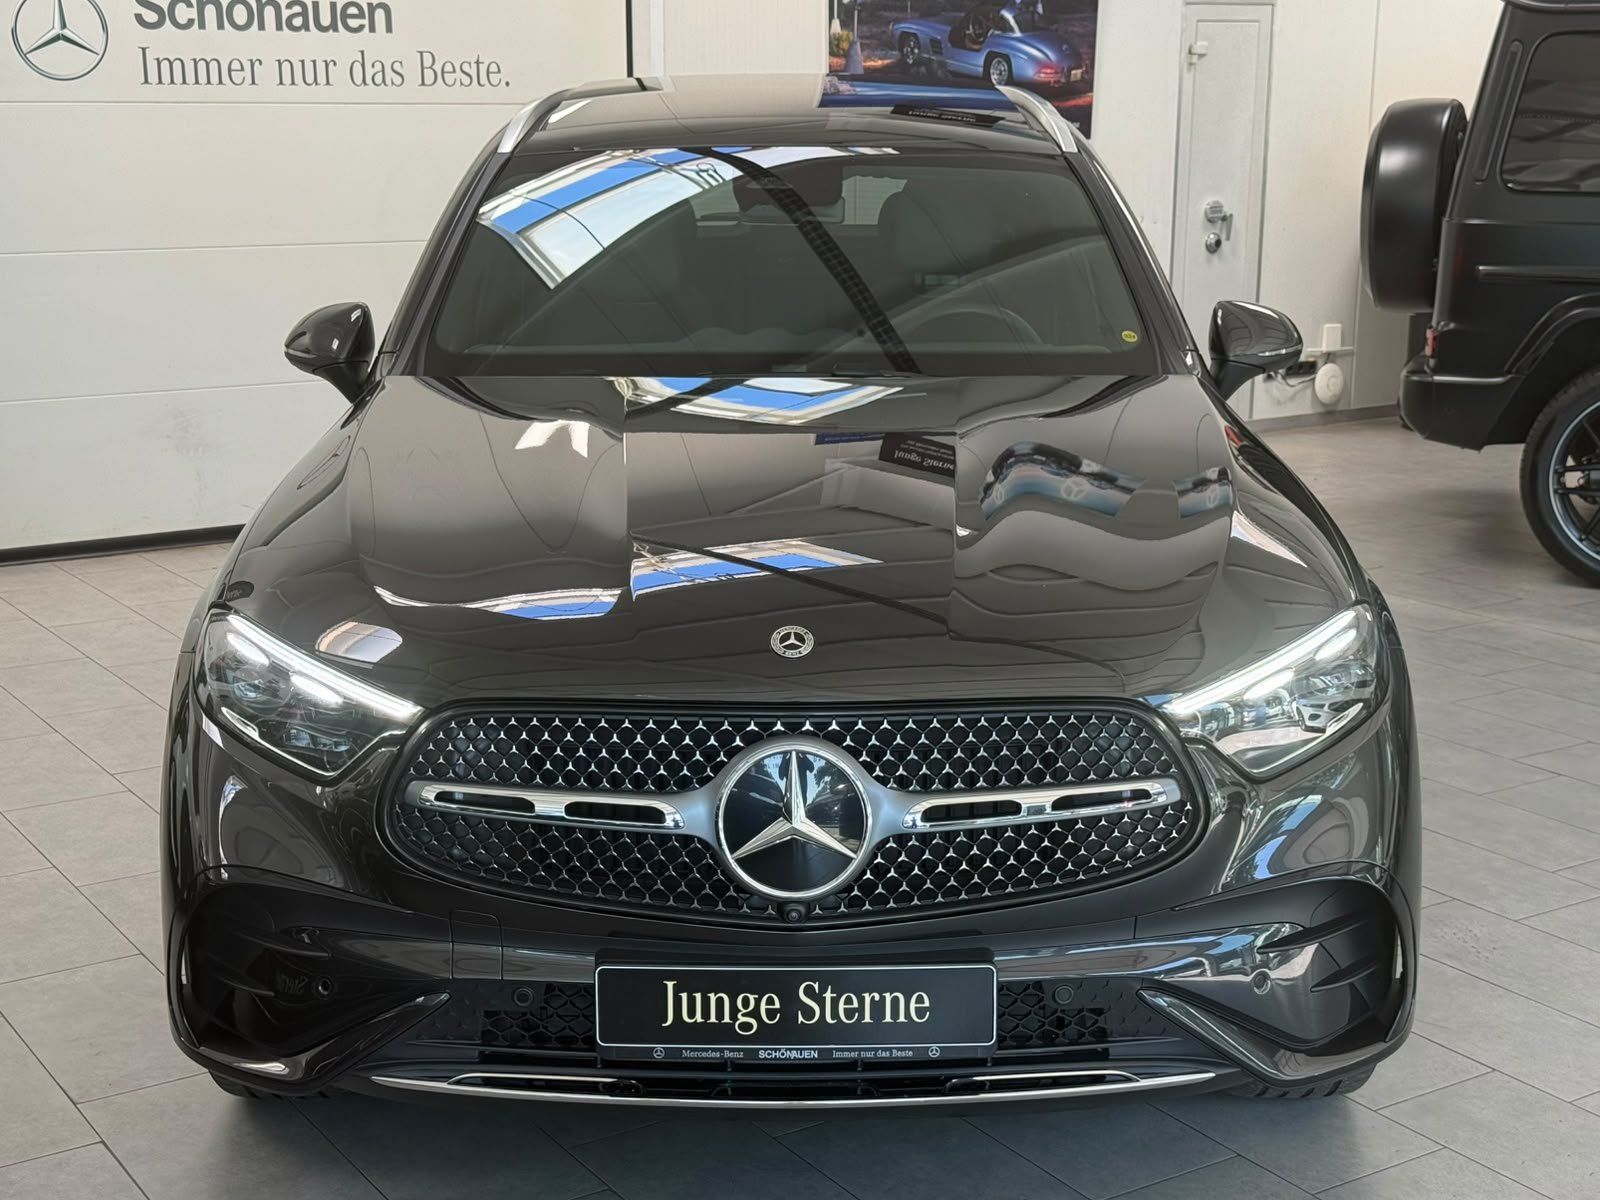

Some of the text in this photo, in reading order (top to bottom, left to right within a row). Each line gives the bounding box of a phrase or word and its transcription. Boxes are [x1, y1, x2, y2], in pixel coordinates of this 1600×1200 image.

[137, 46, 511, 88] Immer nur das Beste.
[662, 979, 931, 1035] Junge Sterne
[682, 1049, 744, 1059] Mercedes-Benz
[832, 1050, 859, 1058] Immer
[876, 1049, 891, 1058] das
[892, 1048, 914, 1058] Beste
